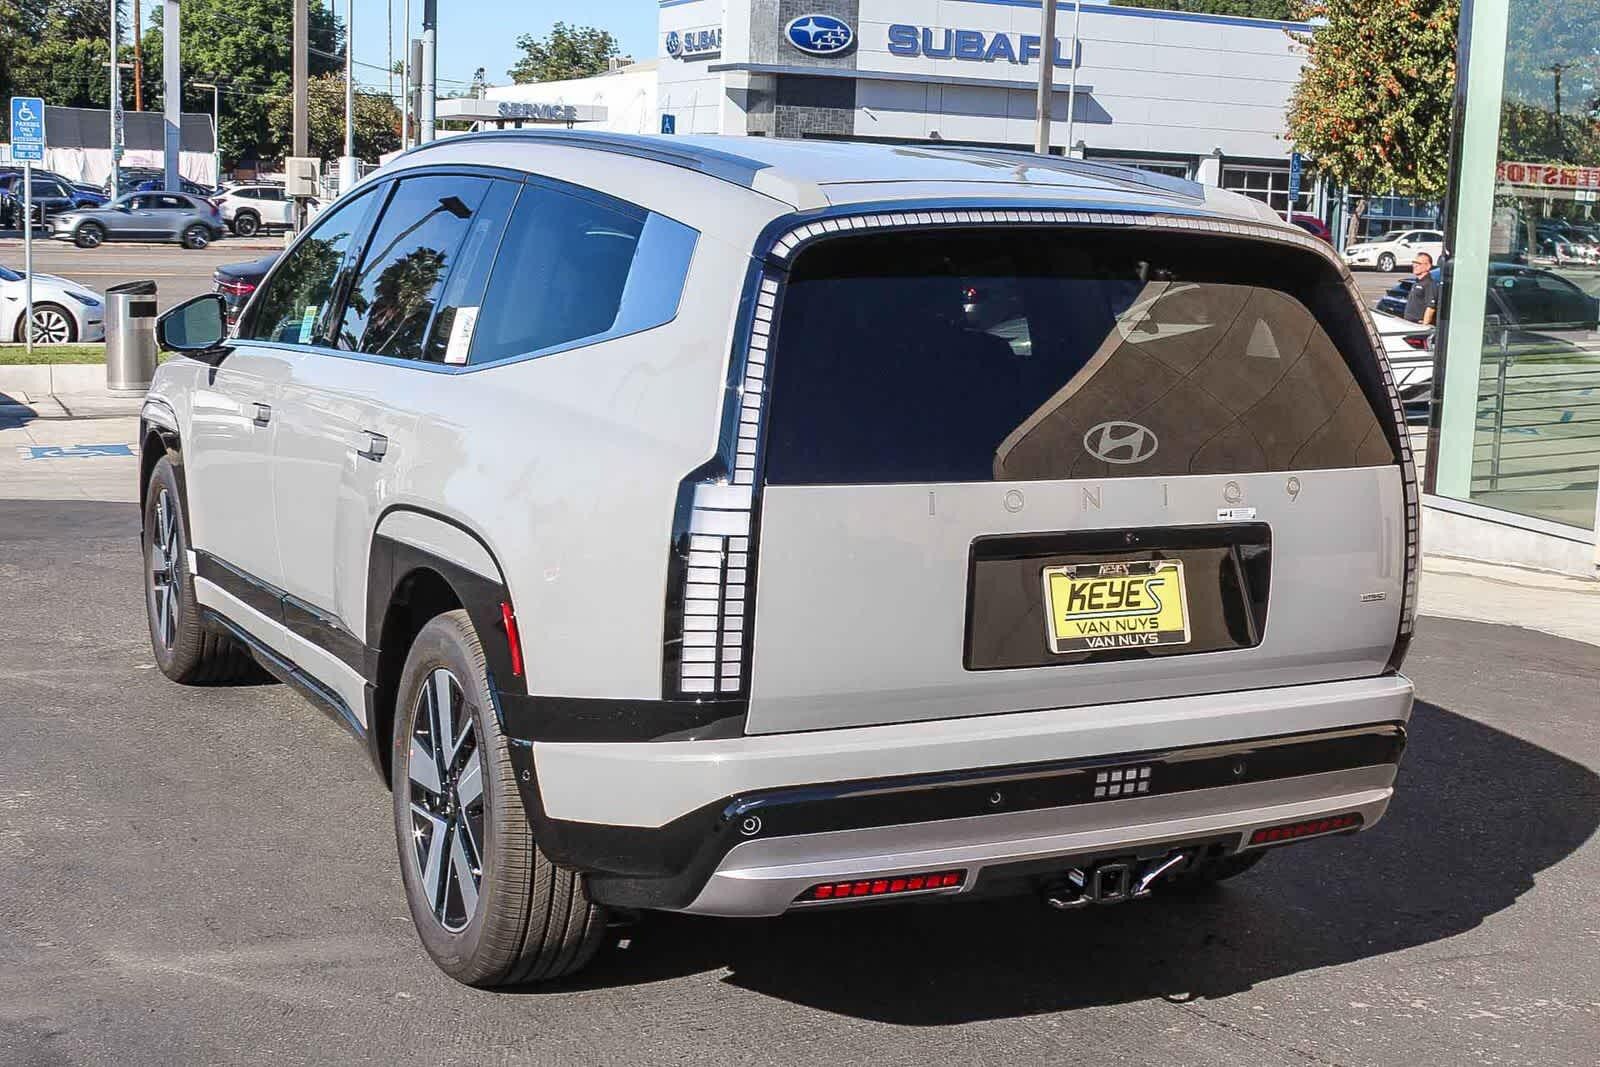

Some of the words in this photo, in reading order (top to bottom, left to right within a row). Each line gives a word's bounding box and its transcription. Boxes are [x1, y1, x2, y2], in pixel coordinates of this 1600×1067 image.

[888, 24, 1082, 69] SUBARU
[498, 102, 577, 119] SERVICE
[928, 480, 1243, 516] IONIQ
[1287, 476, 1301, 502] 9
[1066, 578, 1166, 619] KEYES
[1076, 621, 1110, 634] VAN
[1116, 617, 1159, 632] NUYS
[1085, 635, 1111, 648] VAN
[1118, 633, 1159, 647] NUYS
